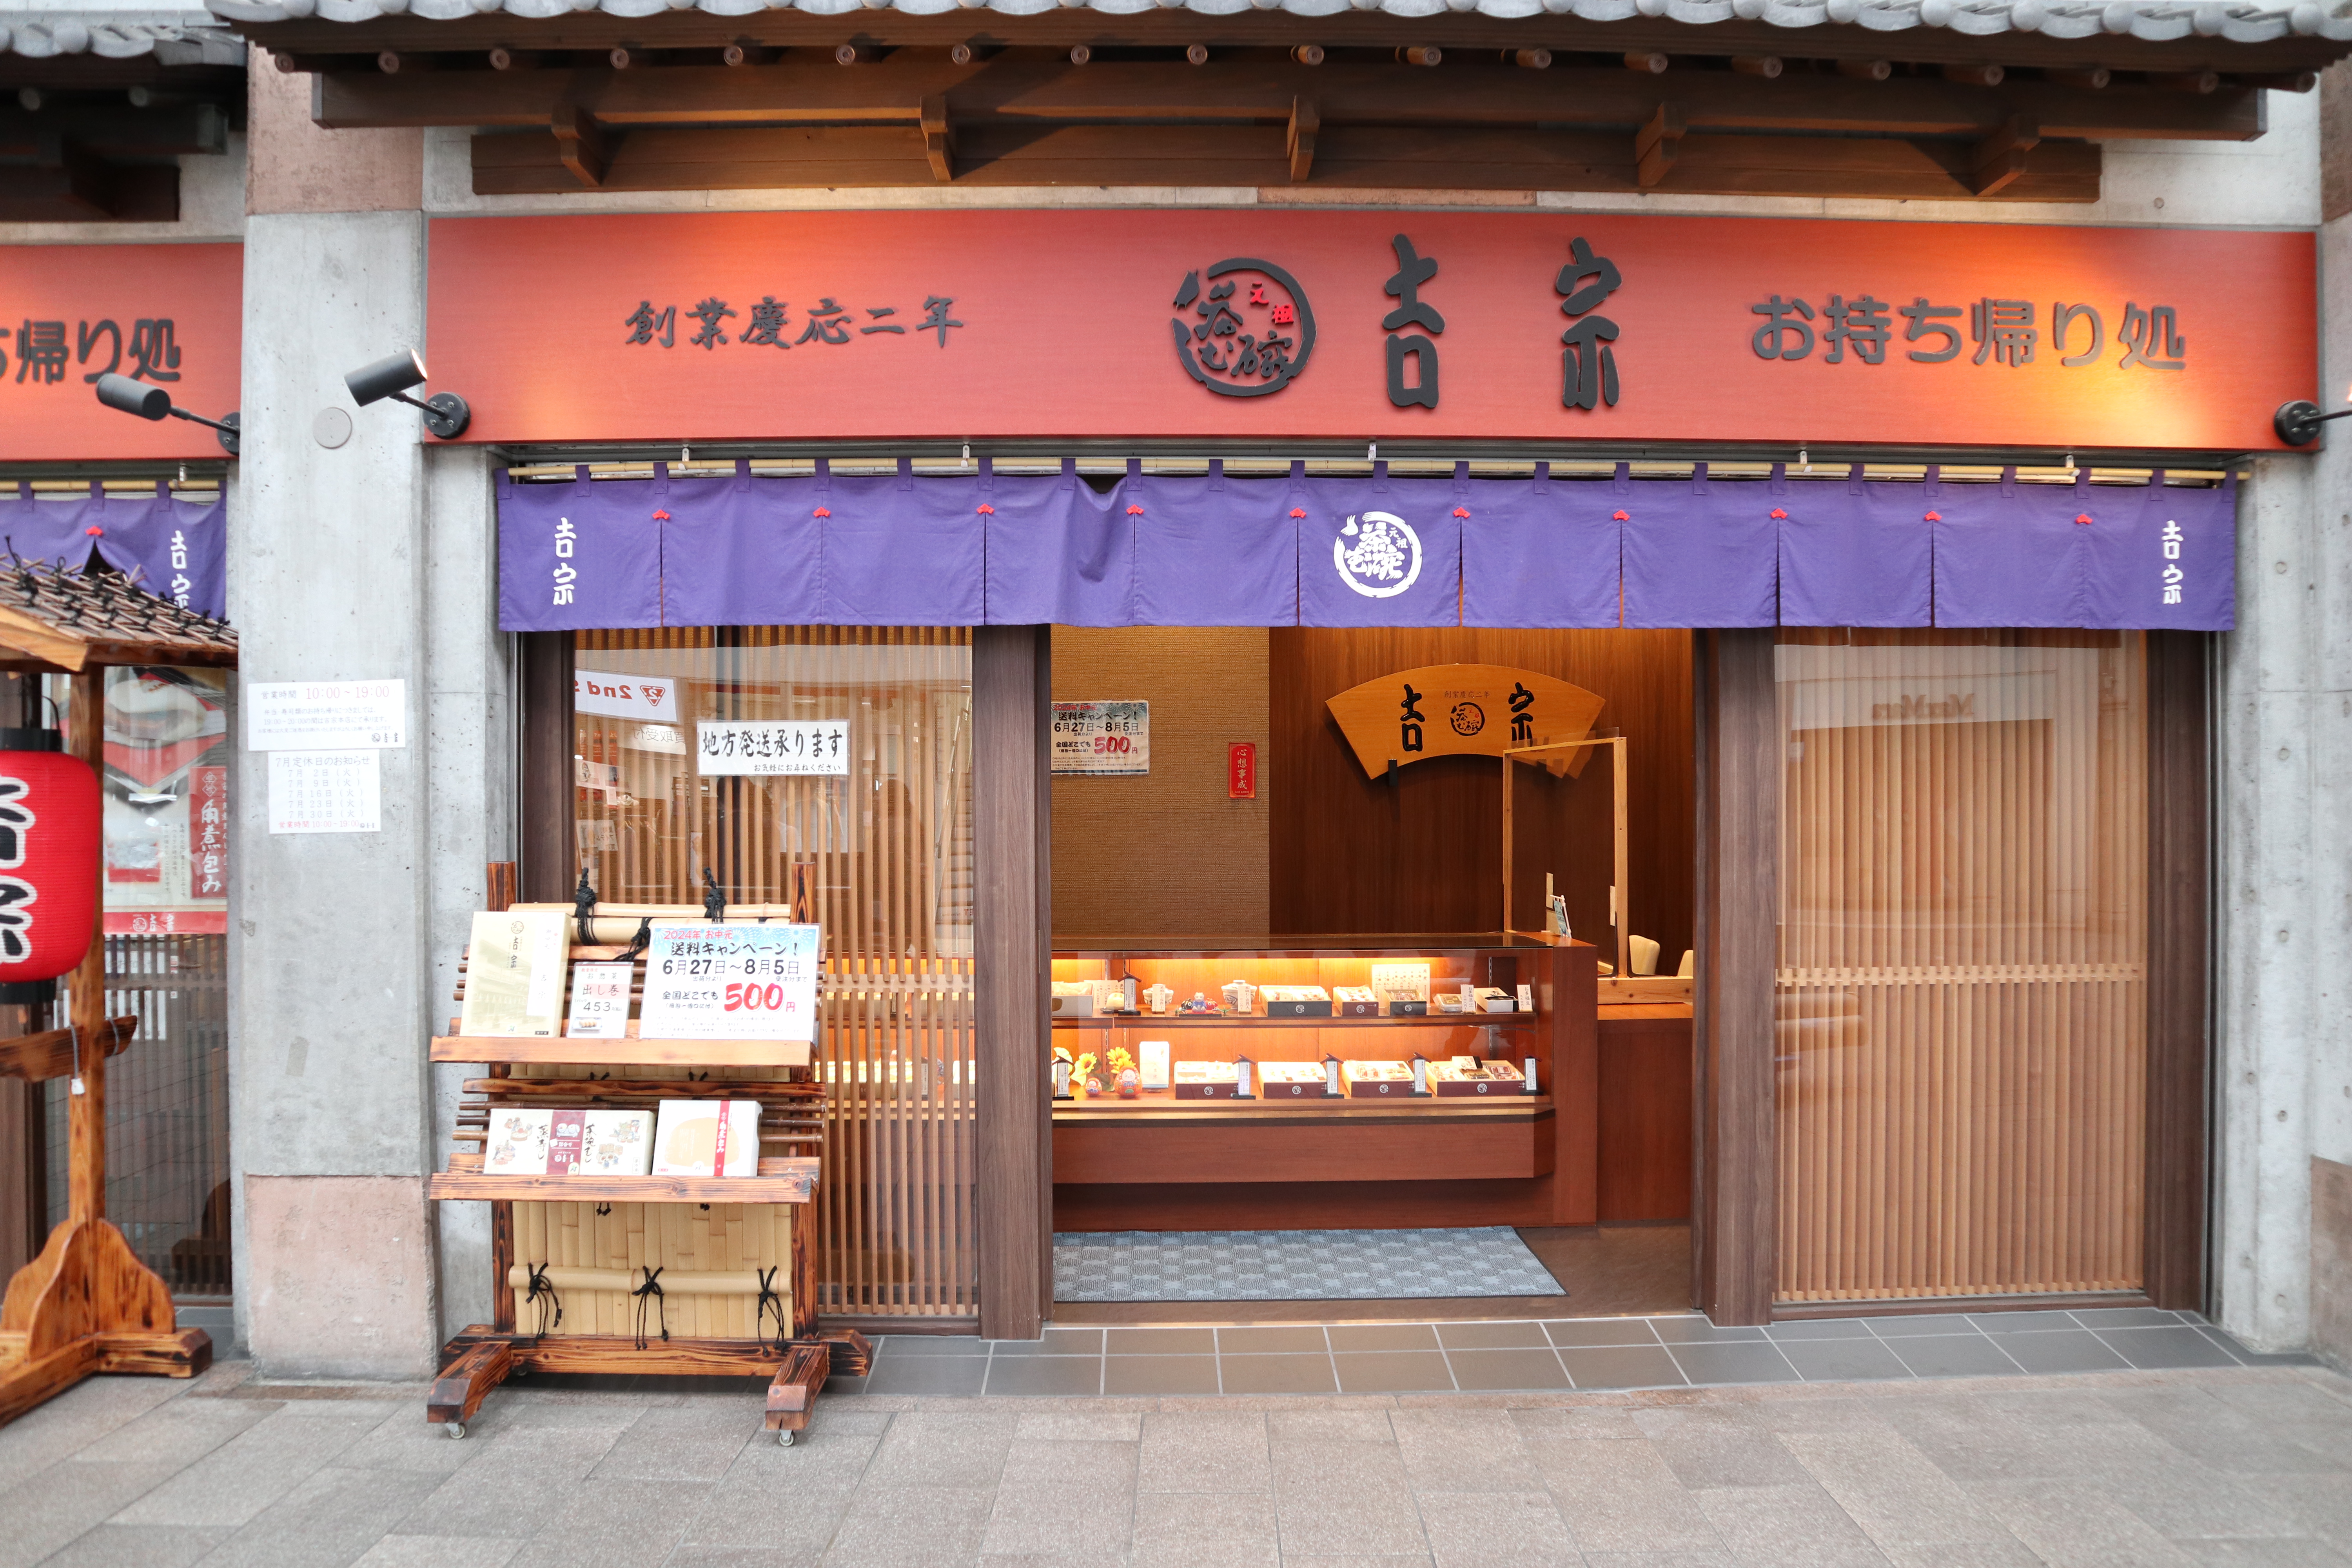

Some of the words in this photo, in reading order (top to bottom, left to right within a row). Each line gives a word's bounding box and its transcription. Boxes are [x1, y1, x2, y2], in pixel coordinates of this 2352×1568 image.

[626, 295, 964, 349] 創業慶応二年
[1382, 233, 1623, 410] 吉宗
[1751, 294, 2186, 370] お持ち帰り処
[0, 319, 181, 384] 帰り処
[1389, 527, 1408, 549] 元祖
[170, 530, 191, 610] 吉宗
[553, 517, 577, 606] 吉宗
[2161, 519, 2184, 605] 吉宗
[261, 690, 296, 700] 営業時間
[1443, 690, 1490, 699] 創業慶応二年
[702, 728, 843, 758] 地方発送承ります
[275, 756, 371, 767] 7月定休日のお知らせ
[753, 764, 841, 772] お気軽にお尋ねください
[1237, 748, 1247, 790] 心想事成
[279, 821, 309, 829] 営業時間
[201, 799, 222, 893] 角煮包み
[664, 930, 701, 940] 2024年
[704, 929, 733, 939] お中元
[510, 936, 519, 968] 吉宗
[583, 984, 619, 996] 出し巻
[662, 991, 719, 1000] 全国どこでも
[535, 1124, 550, 1160] 蒸寿し
[584, 1123, 597, 1163] 茶碗むし
[717, 1121, 727, 1153] 角煮包み
